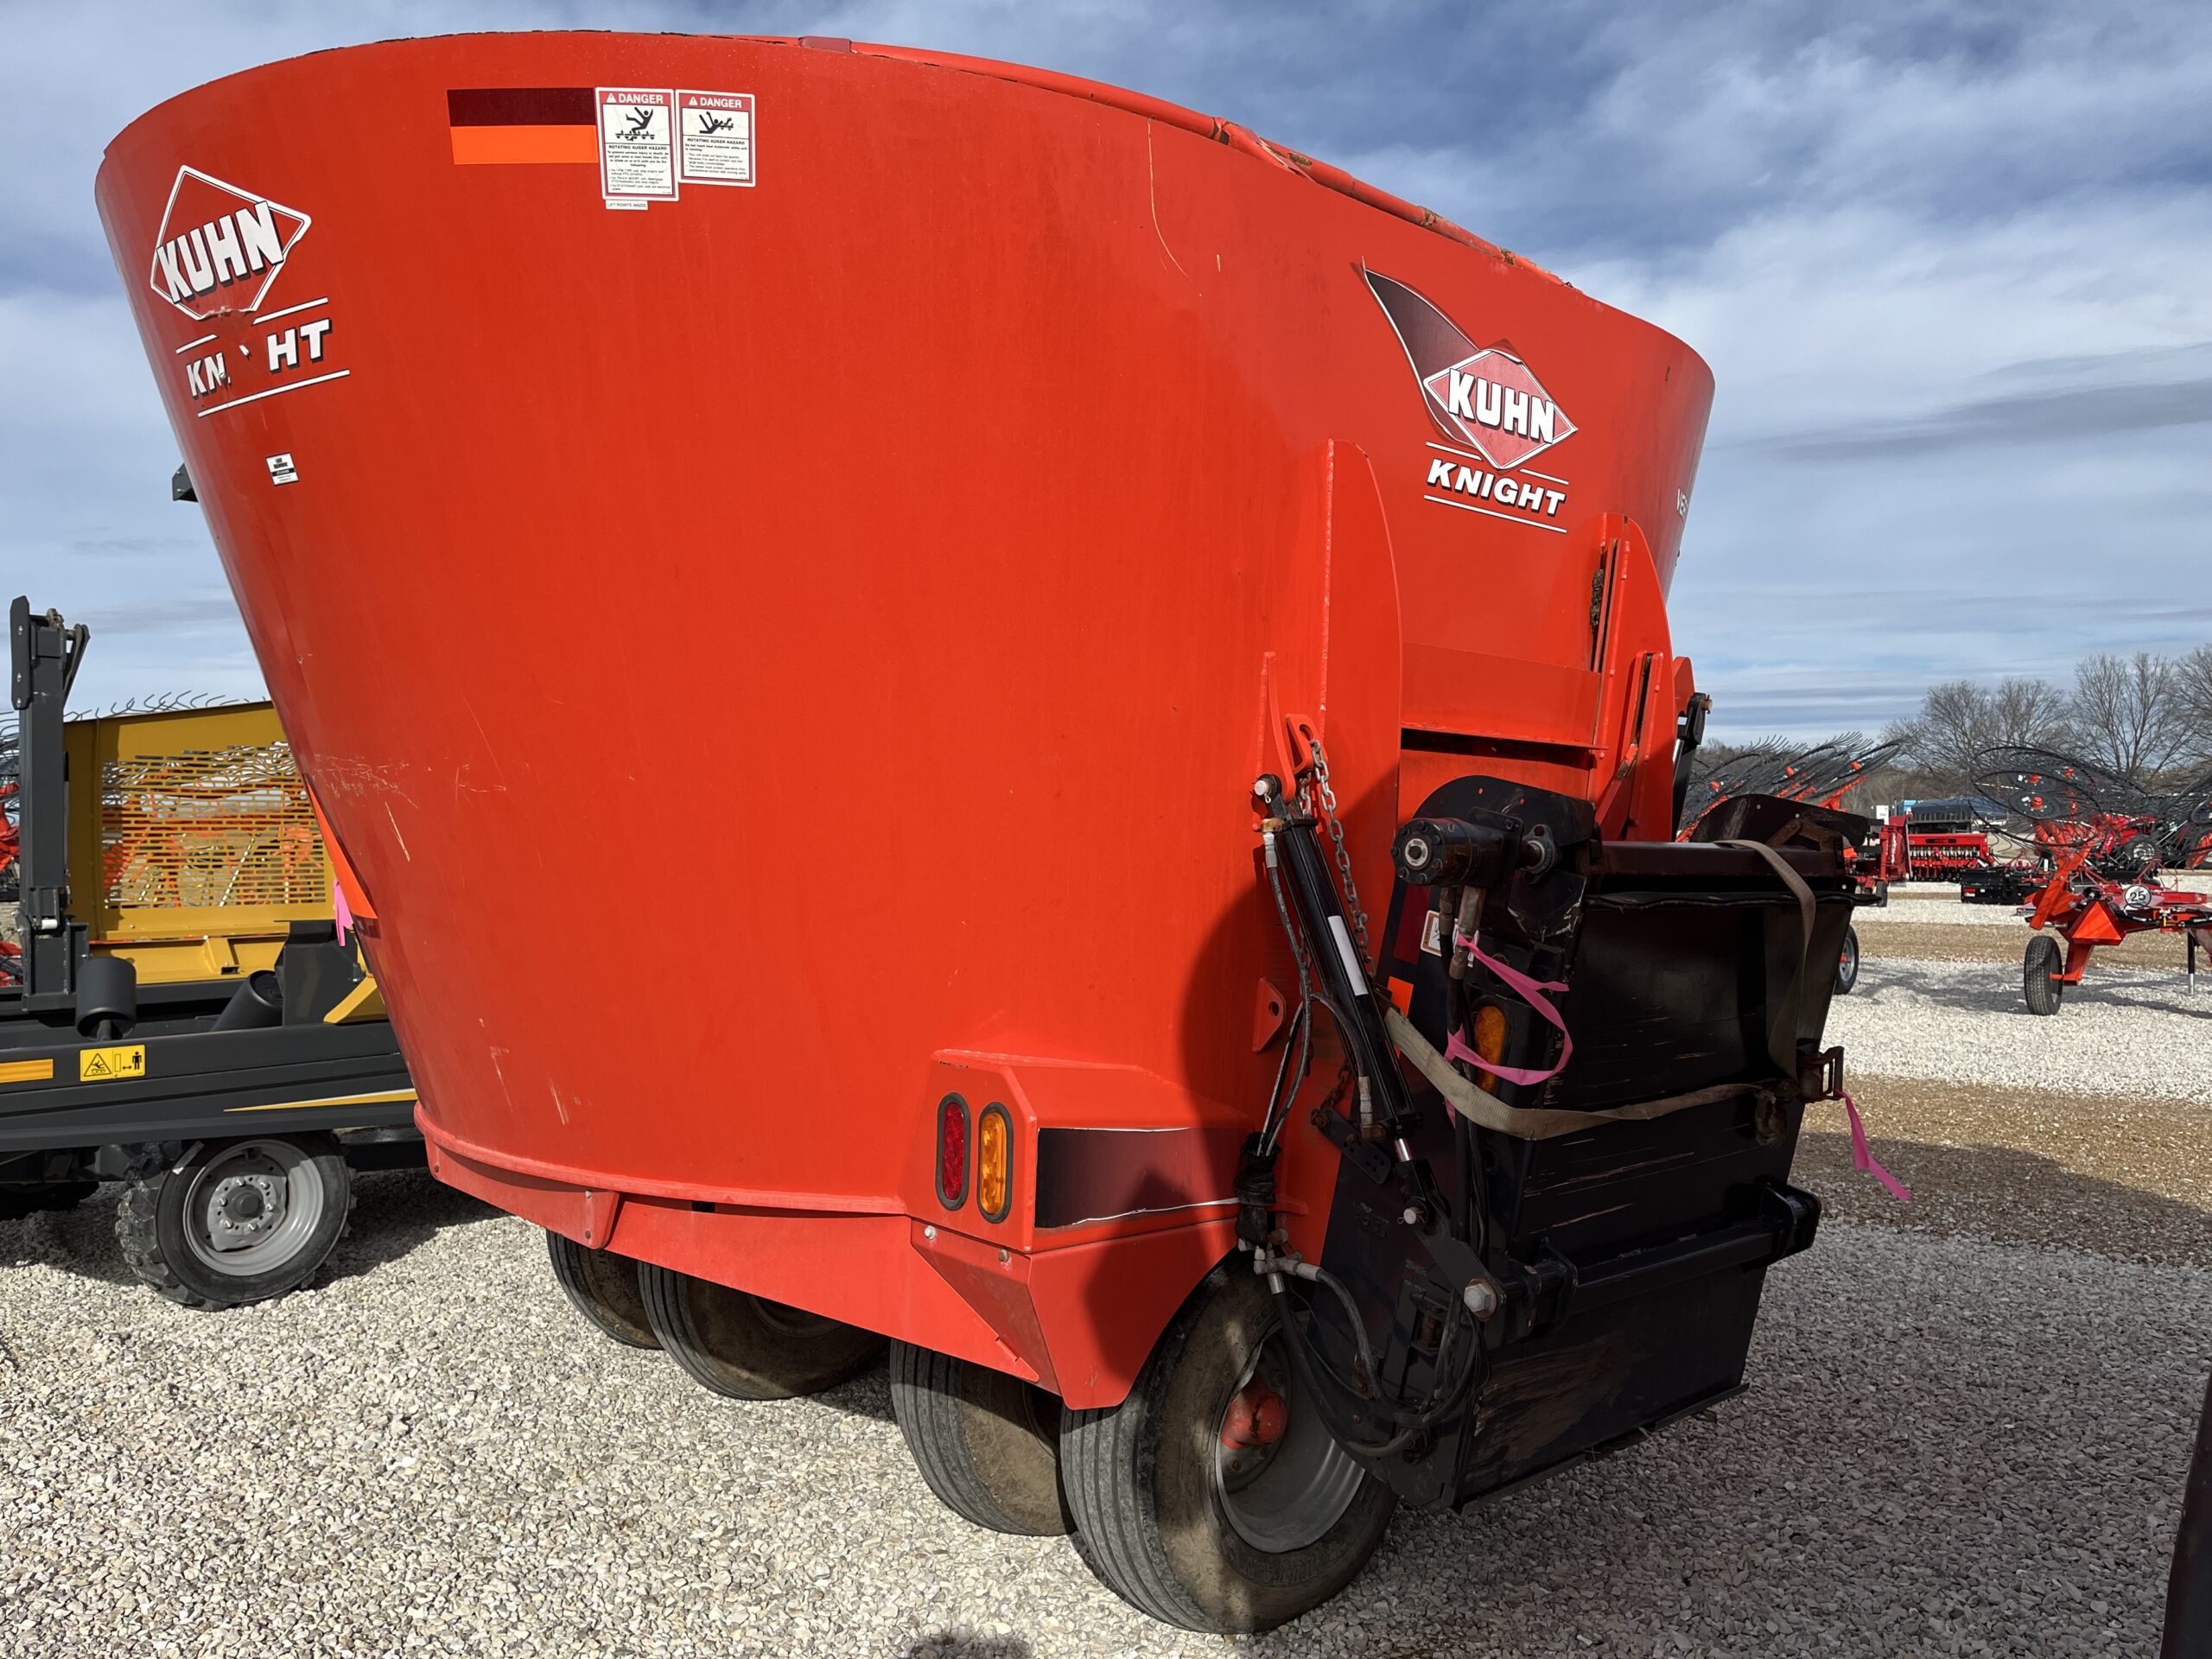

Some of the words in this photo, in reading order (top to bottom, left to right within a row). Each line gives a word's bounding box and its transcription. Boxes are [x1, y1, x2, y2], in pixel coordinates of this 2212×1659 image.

[618, 92, 664, 105] DANGER
[699, 97, 742, 109] DANGER
[156, 200, 285, 305] KUHN
[186, 319, 331, 399] KNHT
[1447, 367, 1555, 444] KUHN
[1427, 458, 1567, 515] KNIGHT
[2130, 890, 2146, 902] 25
